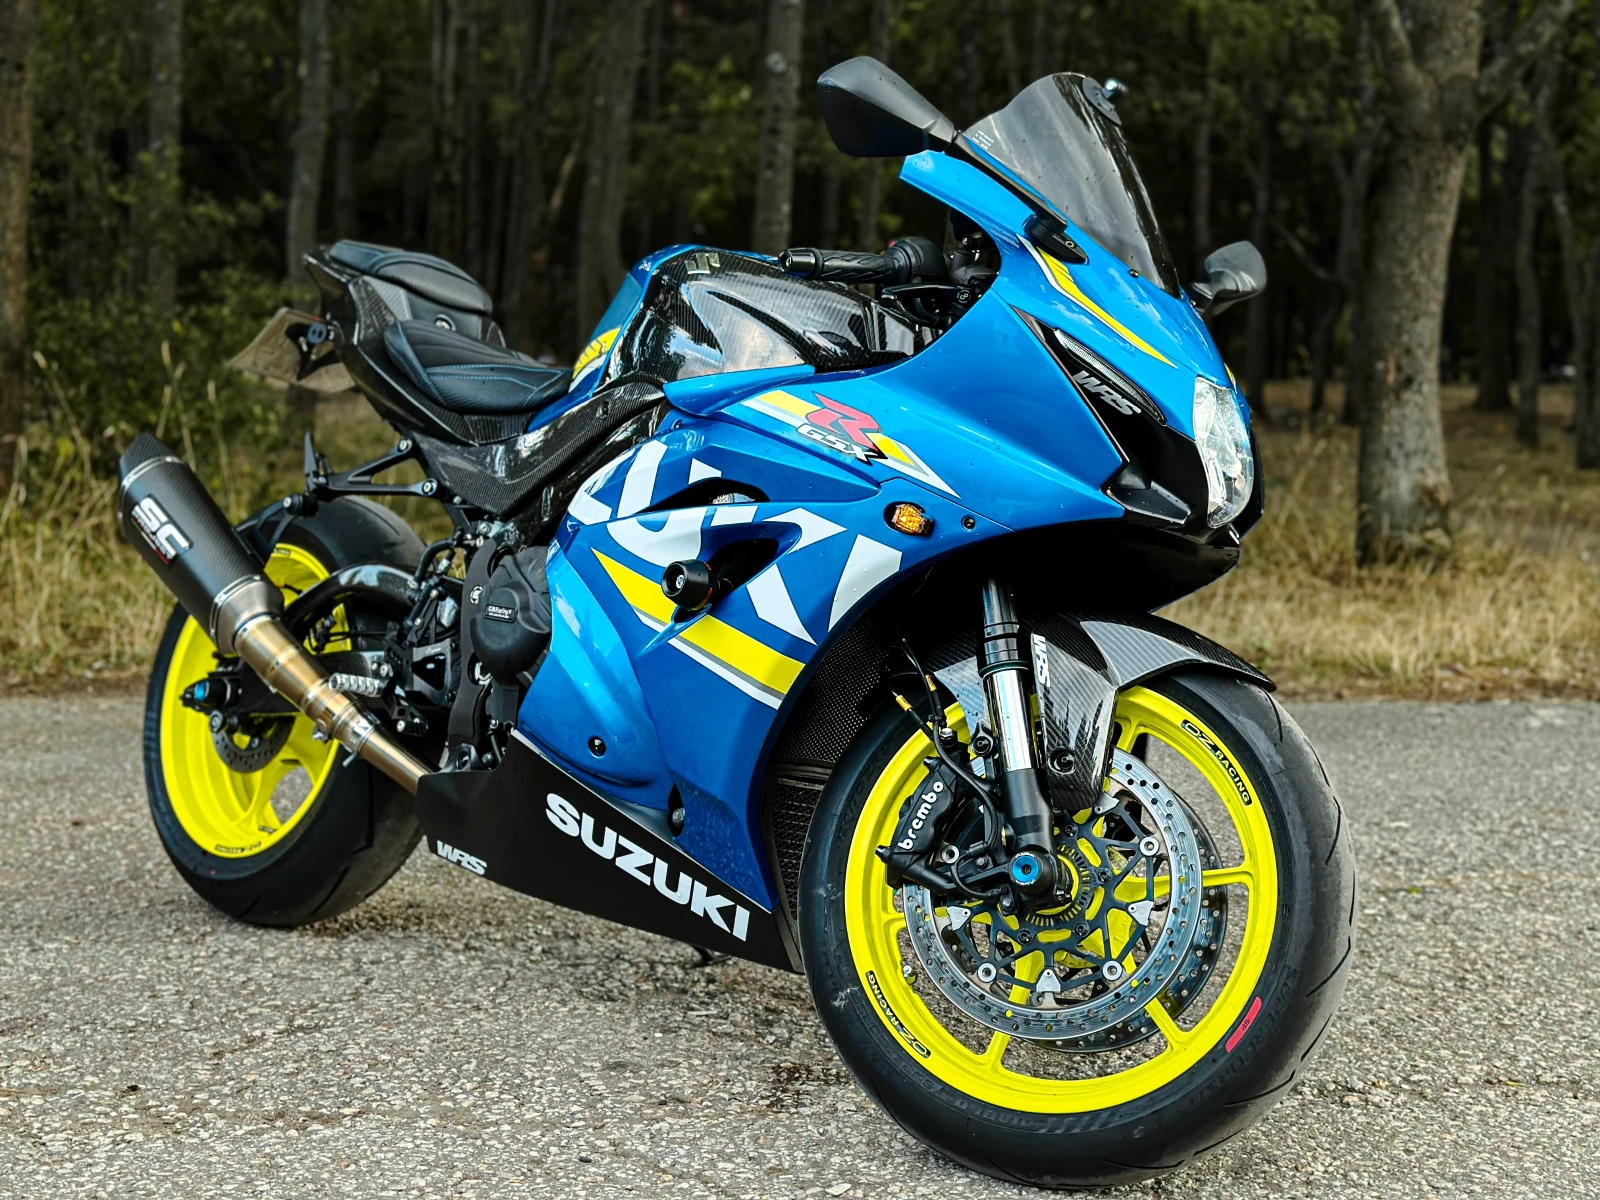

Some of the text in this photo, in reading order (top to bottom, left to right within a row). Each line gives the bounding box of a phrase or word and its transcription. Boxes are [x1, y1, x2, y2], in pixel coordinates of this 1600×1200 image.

[1072, 370, 1142, 415] WRS
[797, 423, 880, 462] GSX
[133, 497, 190, 557] SC
[1033, 633, 1051, 688] WRS
[1185, 722, 1250, 802] OZ RACING
[897, 781, 944, 850] brembo
[436, 839, 487, 875] WRS
[545, 793, 750, 942] SUZUKI
[868, 974, 927, 1055] OZ RACING
